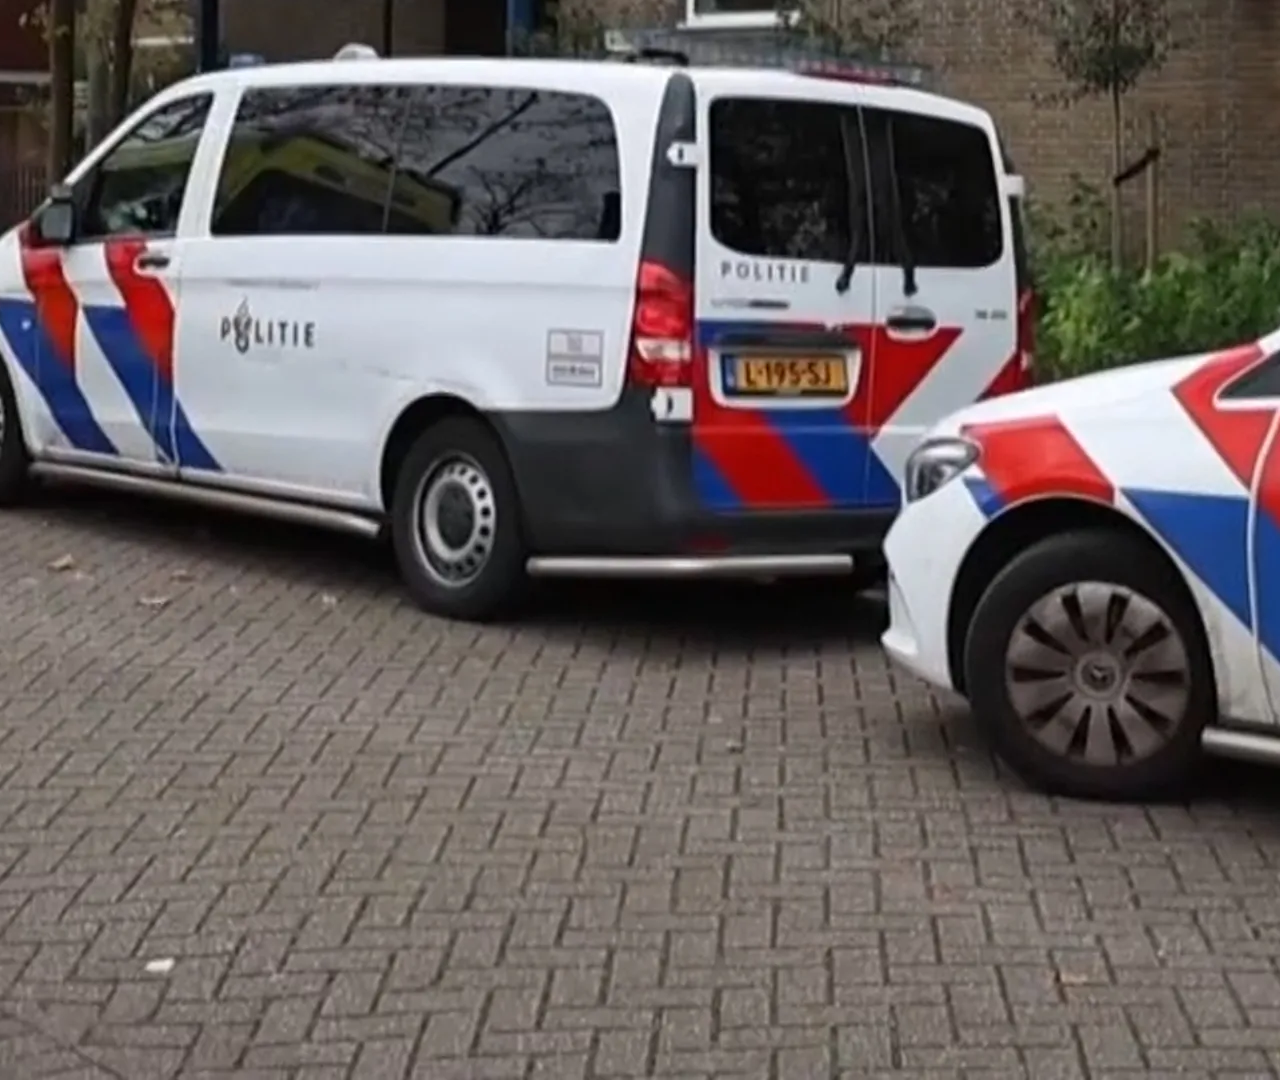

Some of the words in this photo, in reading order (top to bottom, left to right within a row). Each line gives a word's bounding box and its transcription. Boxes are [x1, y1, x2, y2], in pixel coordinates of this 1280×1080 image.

[721, 260, 809, 283] POLITIE
[220, 312, 316, 355] POLITIE
[743, 361, 831, 386] L-195-SJ
